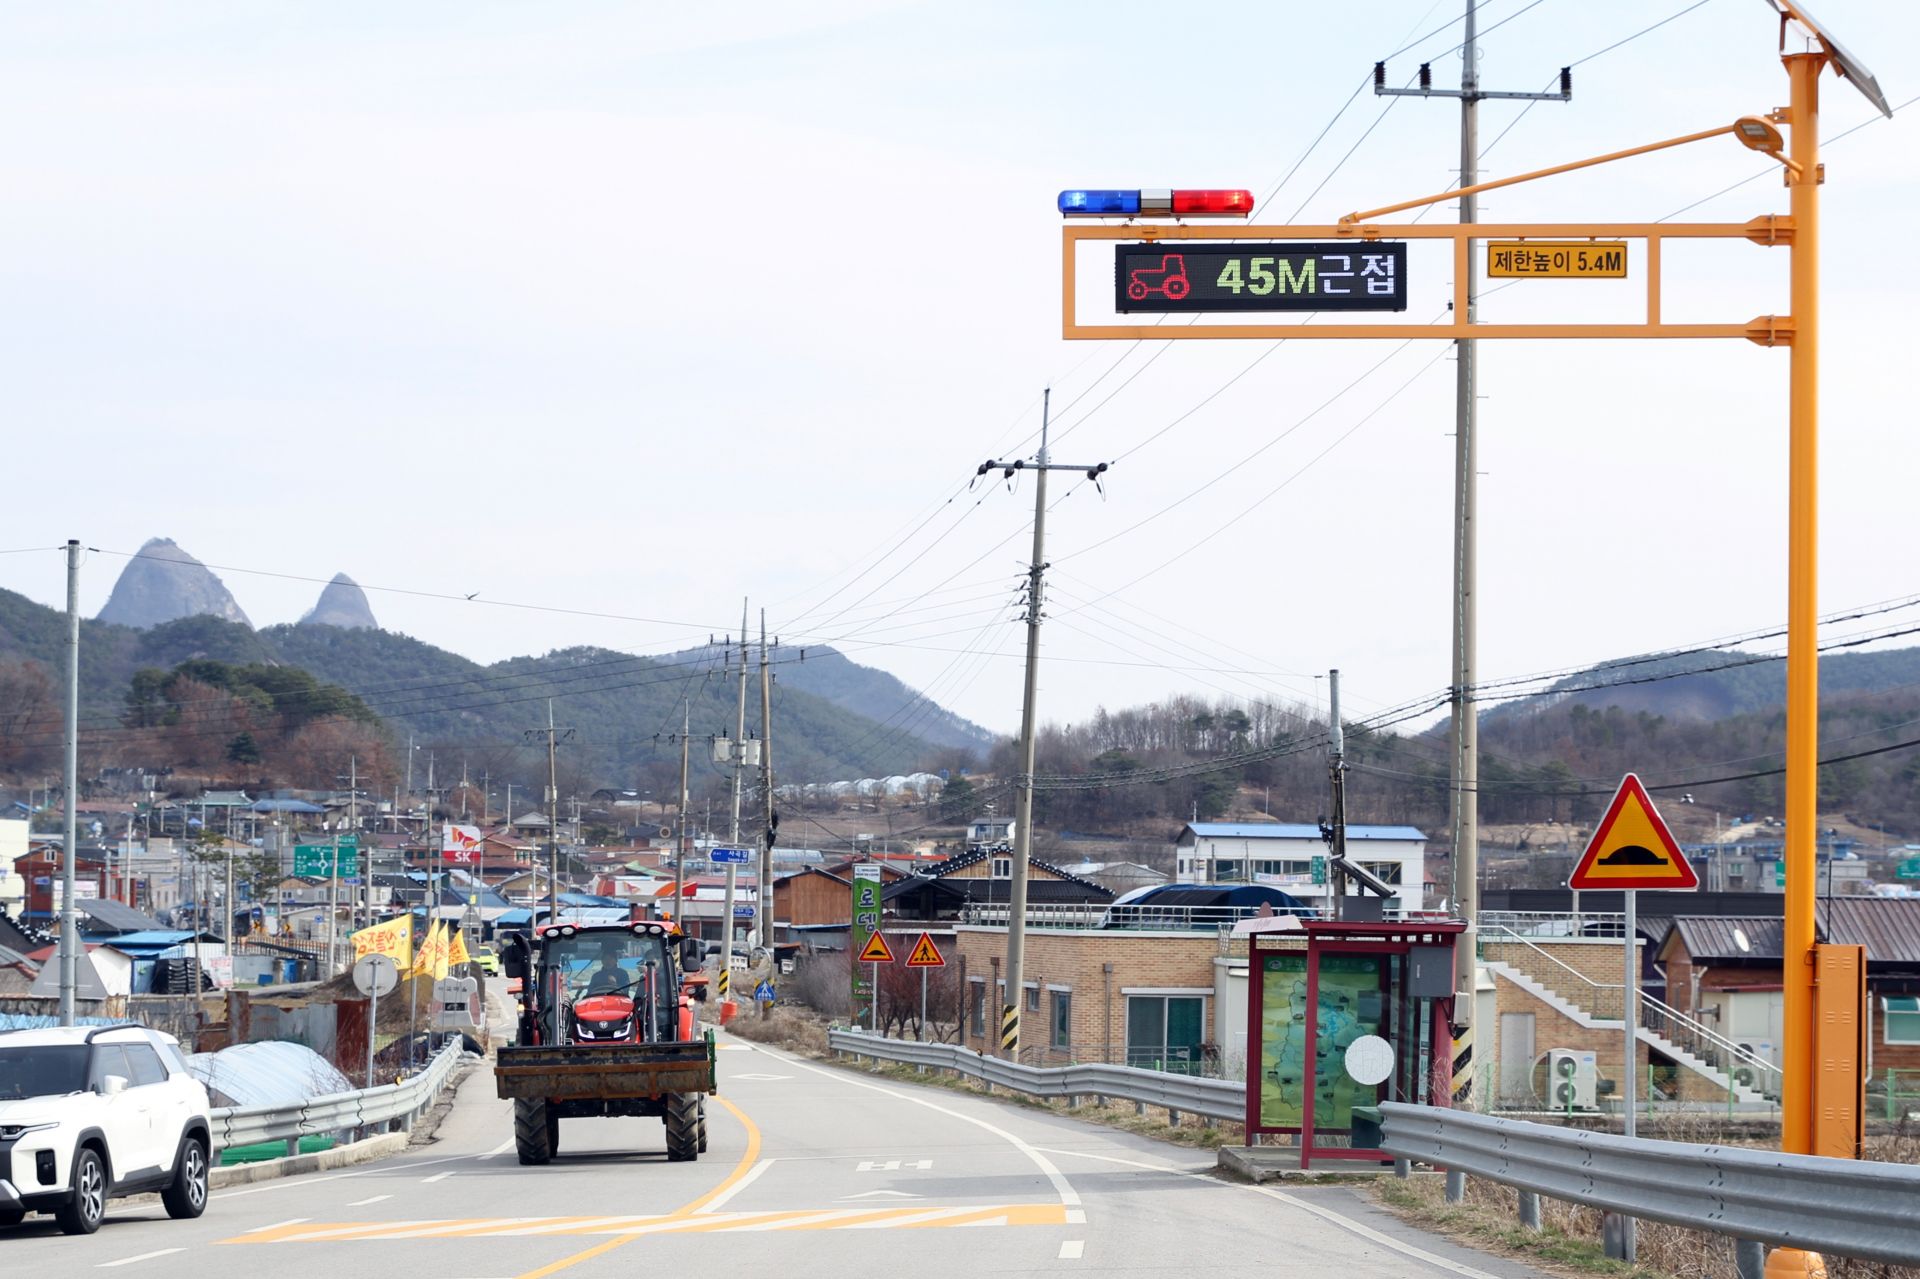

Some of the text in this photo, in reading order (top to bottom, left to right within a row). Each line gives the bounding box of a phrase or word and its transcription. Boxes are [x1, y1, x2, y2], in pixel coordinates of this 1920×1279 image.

[1494, 250, 1621, 272] 제한높이 5.4M
[454, 851, 472, 862] SK
